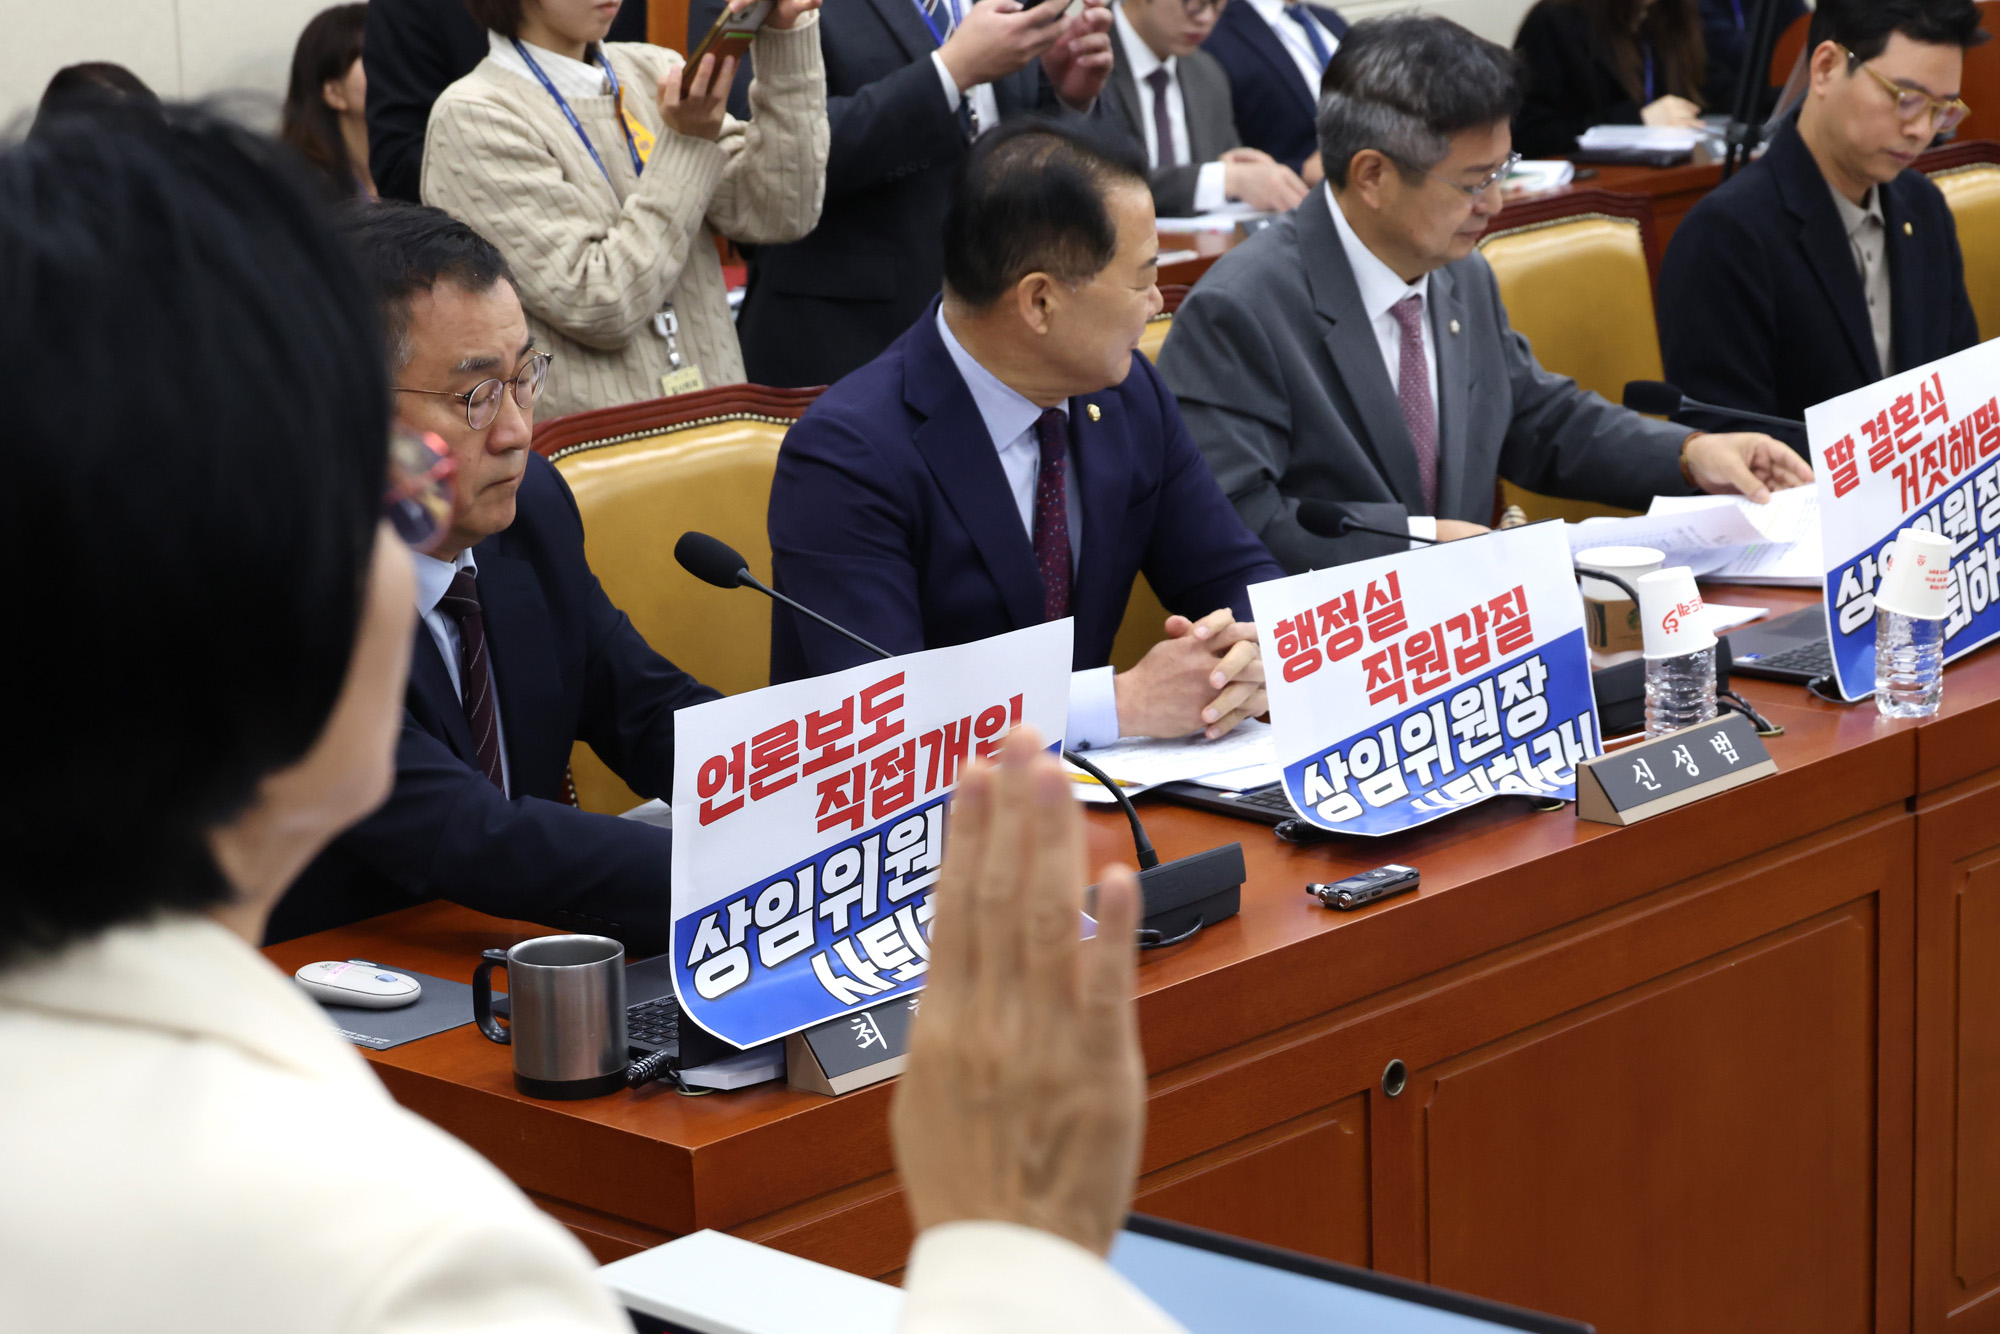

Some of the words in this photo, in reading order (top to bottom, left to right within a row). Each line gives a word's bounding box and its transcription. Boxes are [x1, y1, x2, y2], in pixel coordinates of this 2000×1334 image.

[1823, 432, 1861, 499] 딸
[1861, 371, 1950, 474] 결혼식
[1891, 396, 2000, 515] 거짓해명
[1835, 460, 2000, 636] 상원장
[1273, 569, 1409, 684] 행정실
[1361, 584, 1534, 706] 직원갑질
[697, 671, 905, 827] 언론보도
[1303, 655, 1550, 823] 상임위원장
[1632, 730, 1741, 792] 신성범
[686, 803, 956, 1000] 상임위원
[810, 892, 937, 1006] 사퇴
